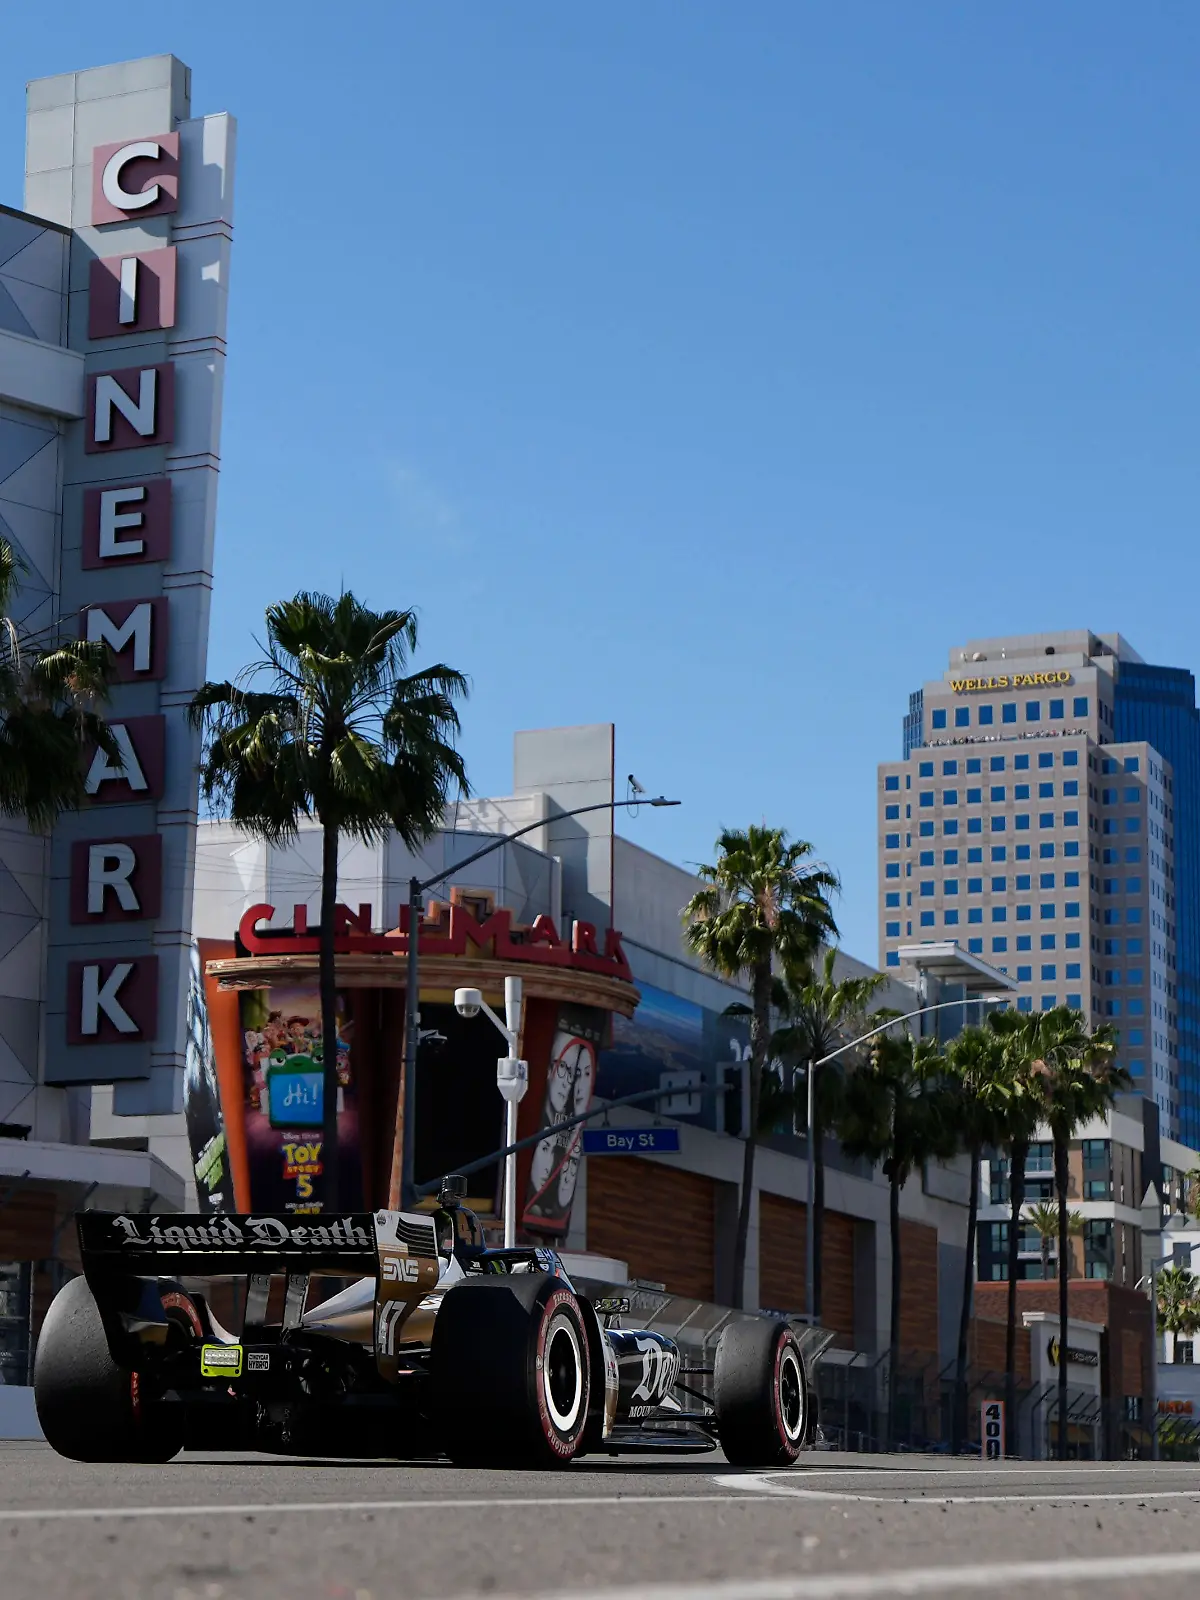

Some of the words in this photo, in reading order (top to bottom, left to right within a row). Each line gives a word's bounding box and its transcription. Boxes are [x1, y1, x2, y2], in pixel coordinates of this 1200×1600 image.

[80, 140, 160, 1036] CINEMARK
[949, 675, 1009, 693] WELLS
[1012, 670, 1071, 687] FARGO
[283, 1083, 319, 1107] Hi!
[281, 1142, 323, 1164] TOY
[607, 1134, 634, 1150] Bay
[638, 1134, 655, 1147] St
[296, 1173, 314, 1199] 5
[112, 1215, 244, 1250] Liquid
[245, 1216, 370, 1247] Death
